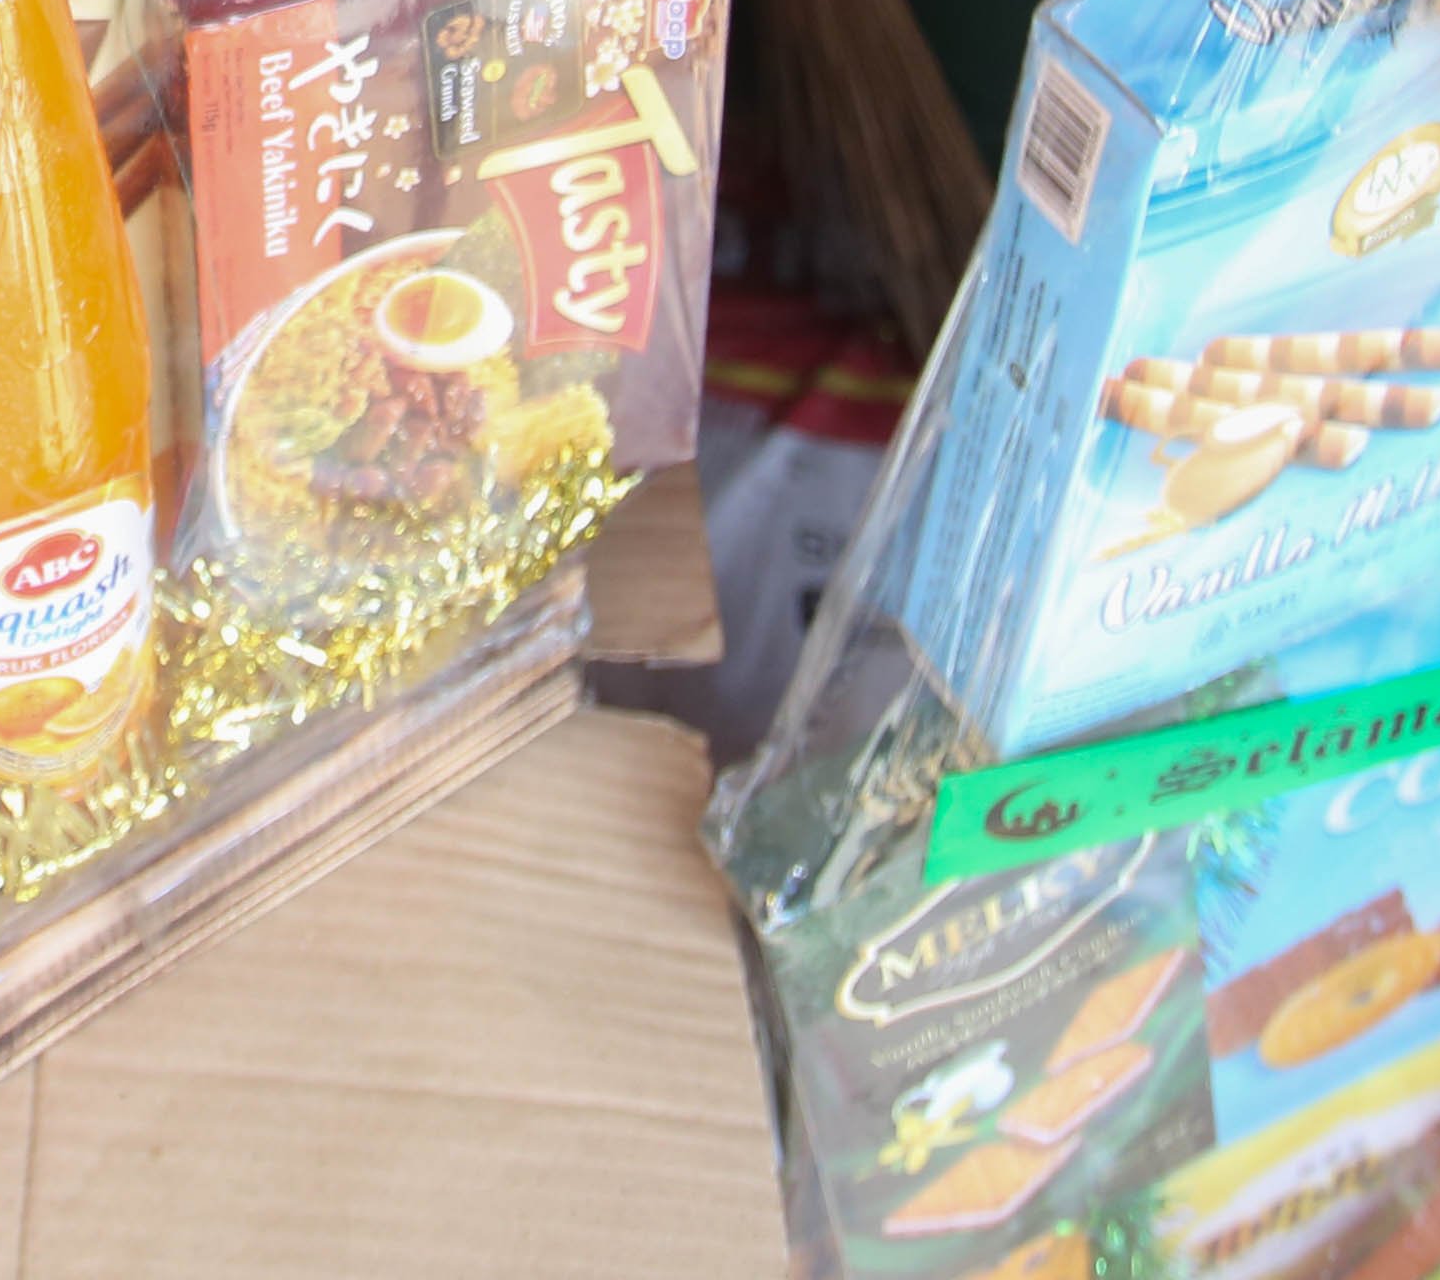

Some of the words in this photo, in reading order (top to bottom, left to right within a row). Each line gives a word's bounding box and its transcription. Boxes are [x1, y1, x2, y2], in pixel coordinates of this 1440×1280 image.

[258, 50, 296, 123] Beef
[288, 33, 381, 248] やきにく
[459, 56, 483, 145] Seaweed
[261, 127, 299, 258] Yakiniku
[476, 66, 700, 334] Tasty
[12, 541, 96, 591] ABC
[1101, 522, 1316, 636] Vanilla
